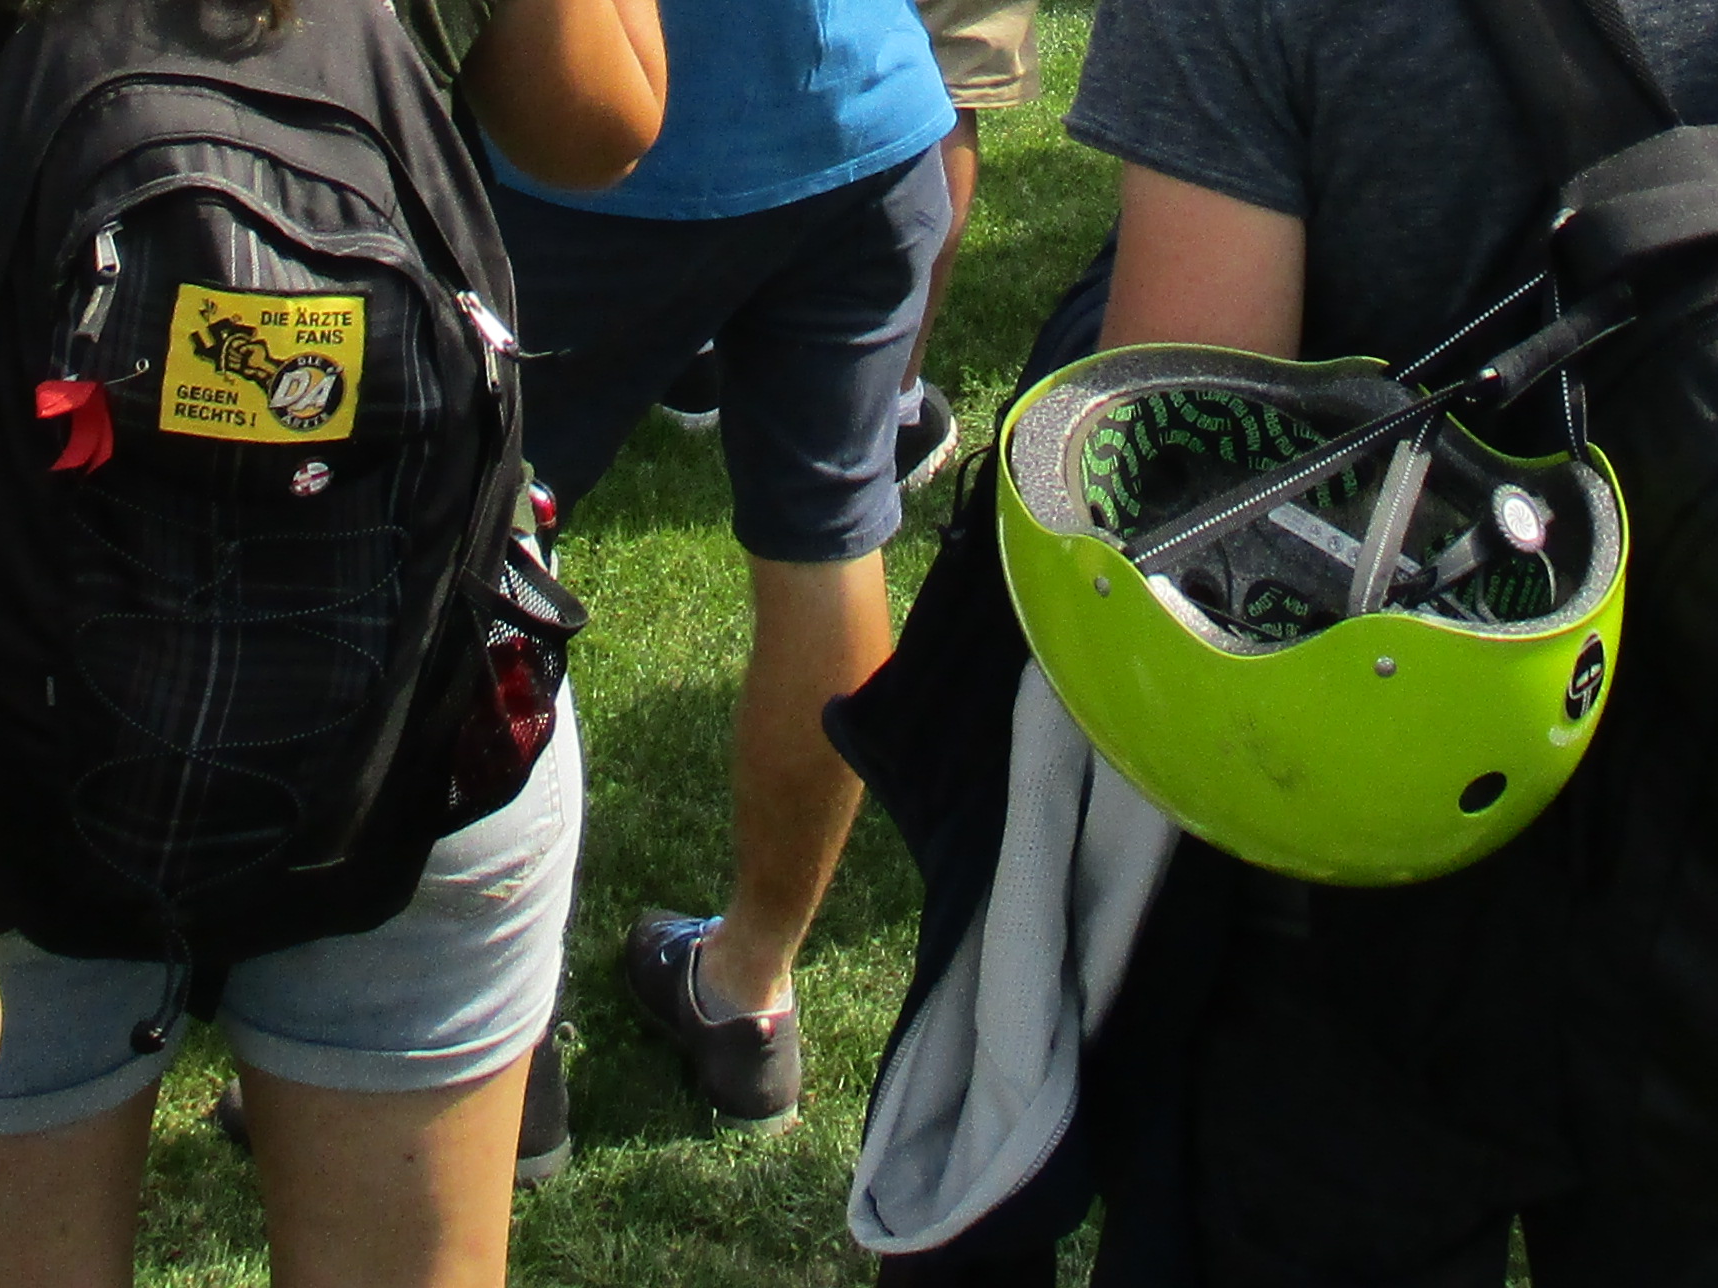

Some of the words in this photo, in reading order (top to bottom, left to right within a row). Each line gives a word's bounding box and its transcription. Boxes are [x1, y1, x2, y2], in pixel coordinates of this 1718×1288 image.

[260, 310, 289, 327] DIE
[296, 307, 353, 328] ÄRZTE
[295, 329, 344, 345] FANS
[176, 385, 239, 405] GEGEN
[174, 402, 245, 425] RECHTS
